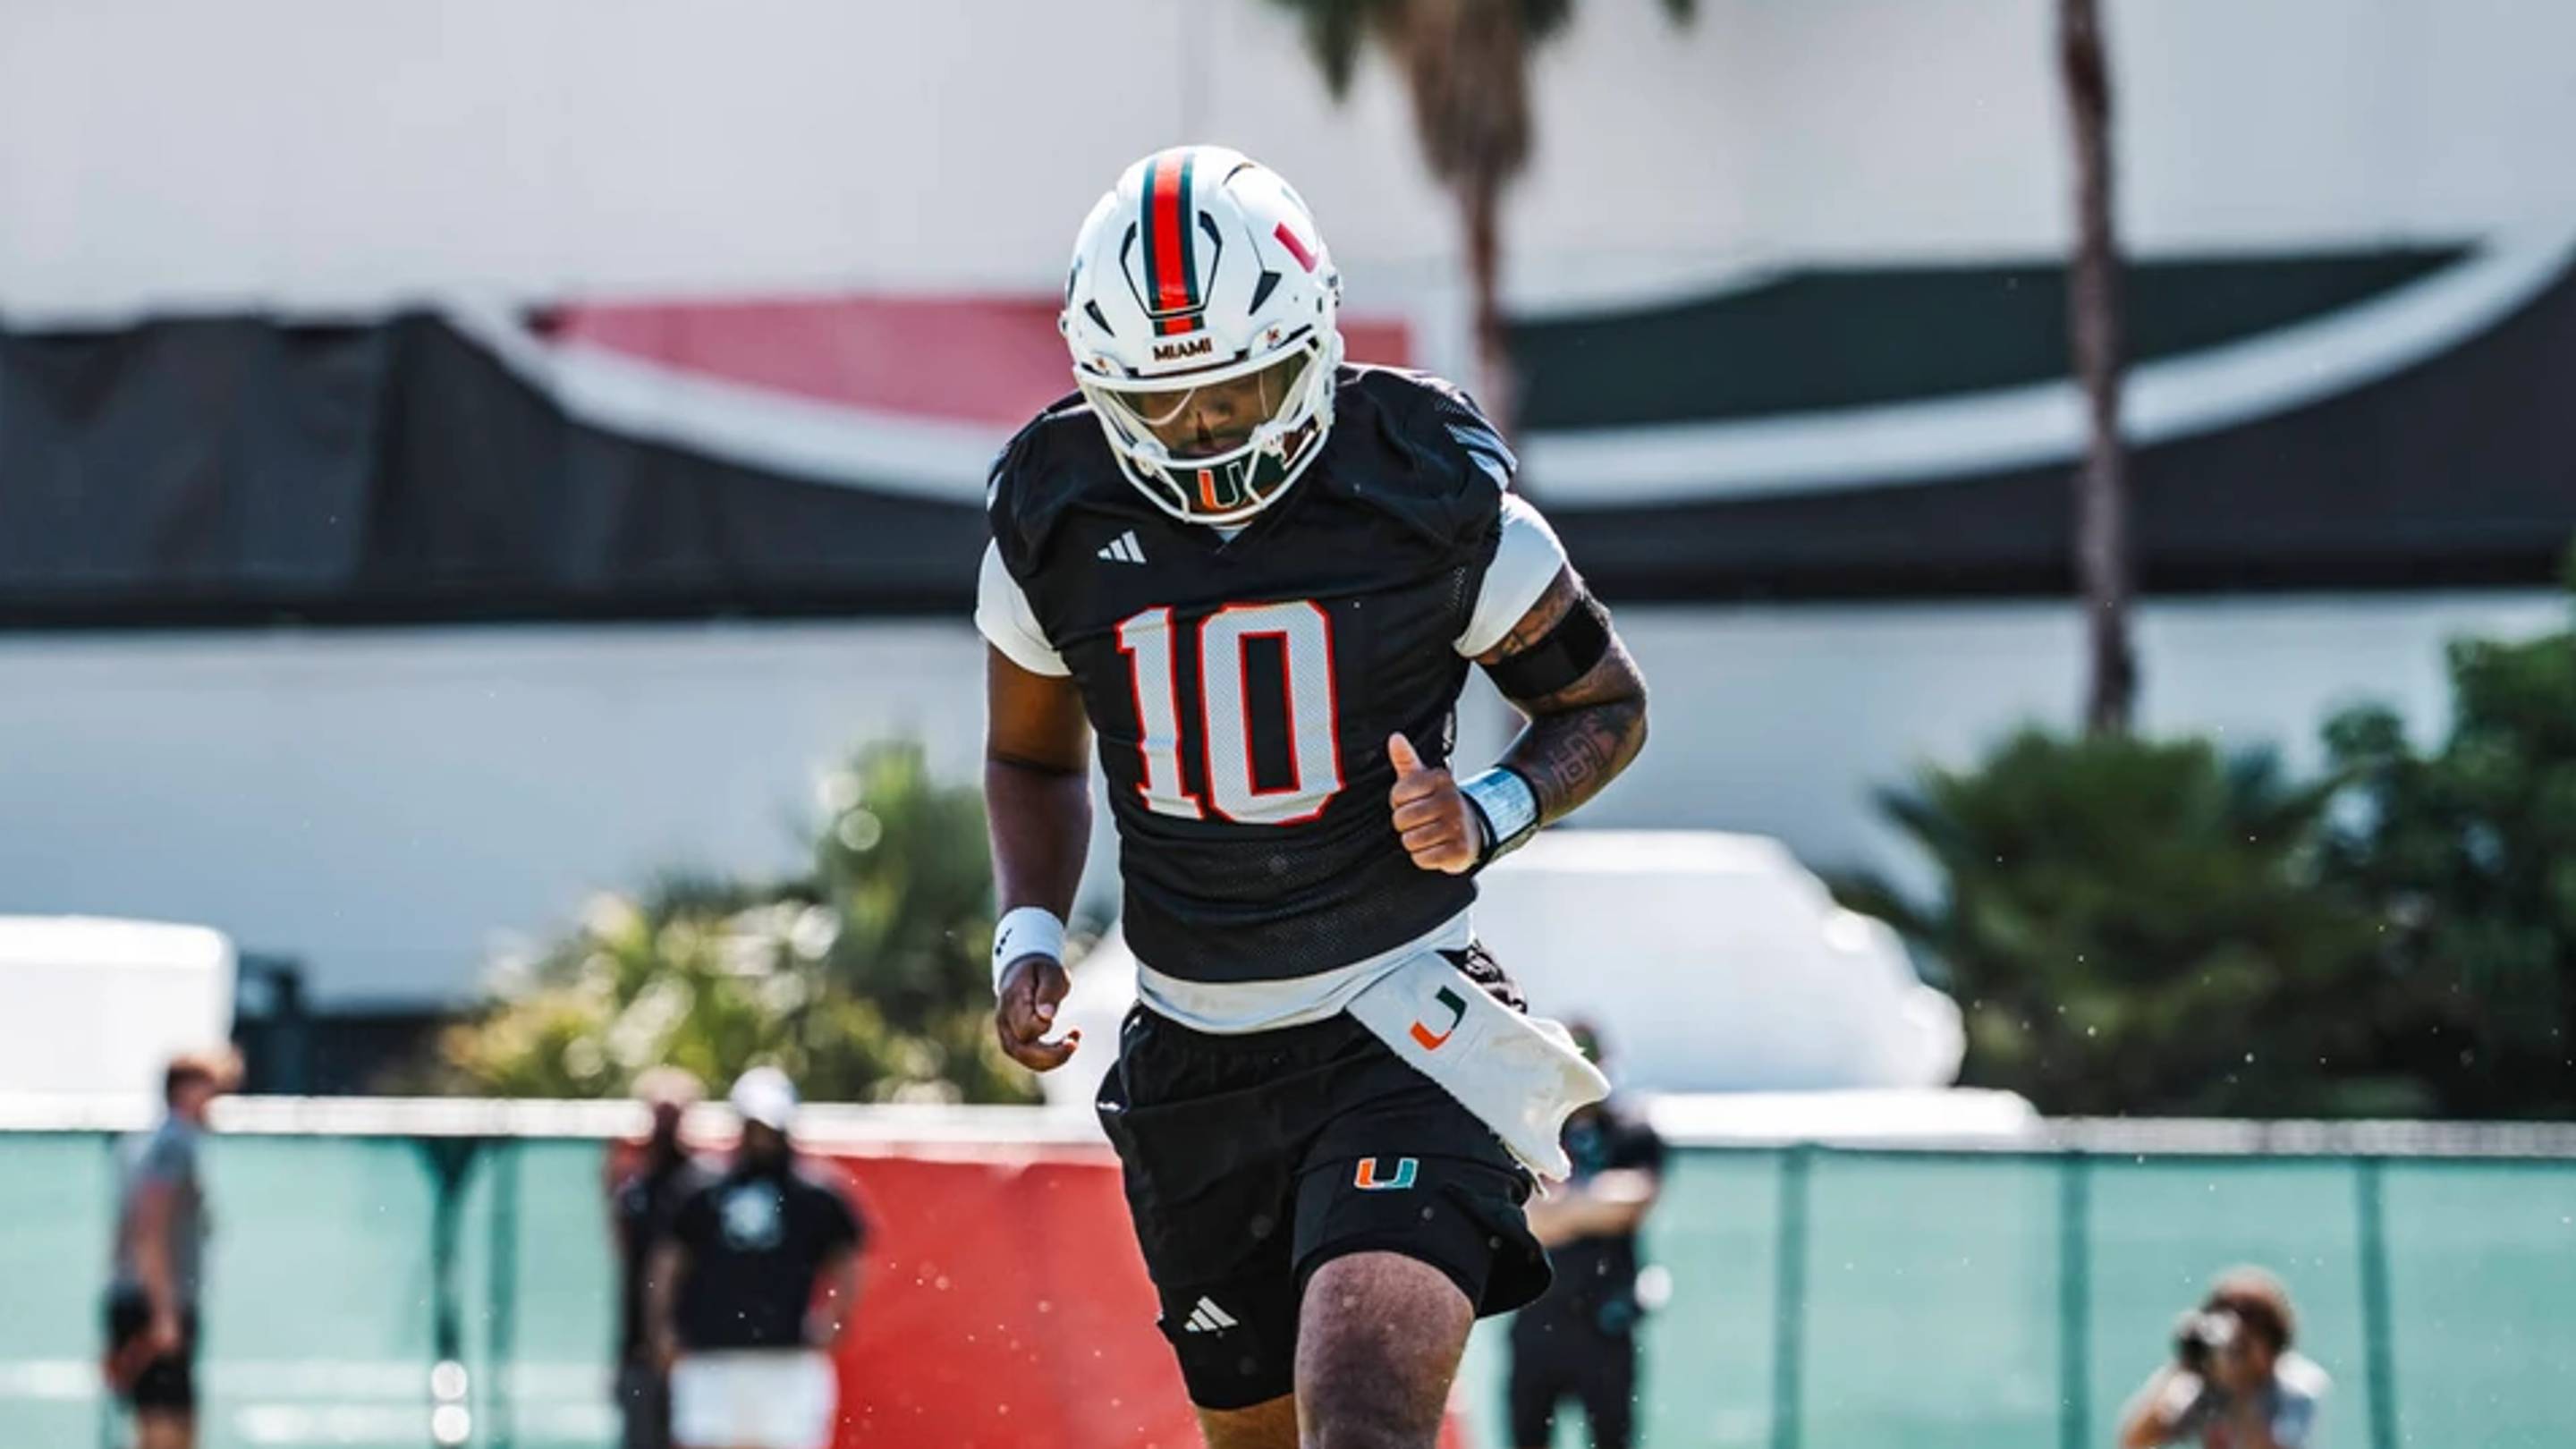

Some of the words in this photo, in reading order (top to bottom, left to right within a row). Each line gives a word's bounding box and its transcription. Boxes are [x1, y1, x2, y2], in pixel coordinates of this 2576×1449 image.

[1153, 336, 1212, 361] MIAMI
[1197, 460, 1250, 510] U
[1114, 597, 1348, 826] 10
[1410, 985, 1468, 1052] U
[1353, 1157, 1419, 1190] U
